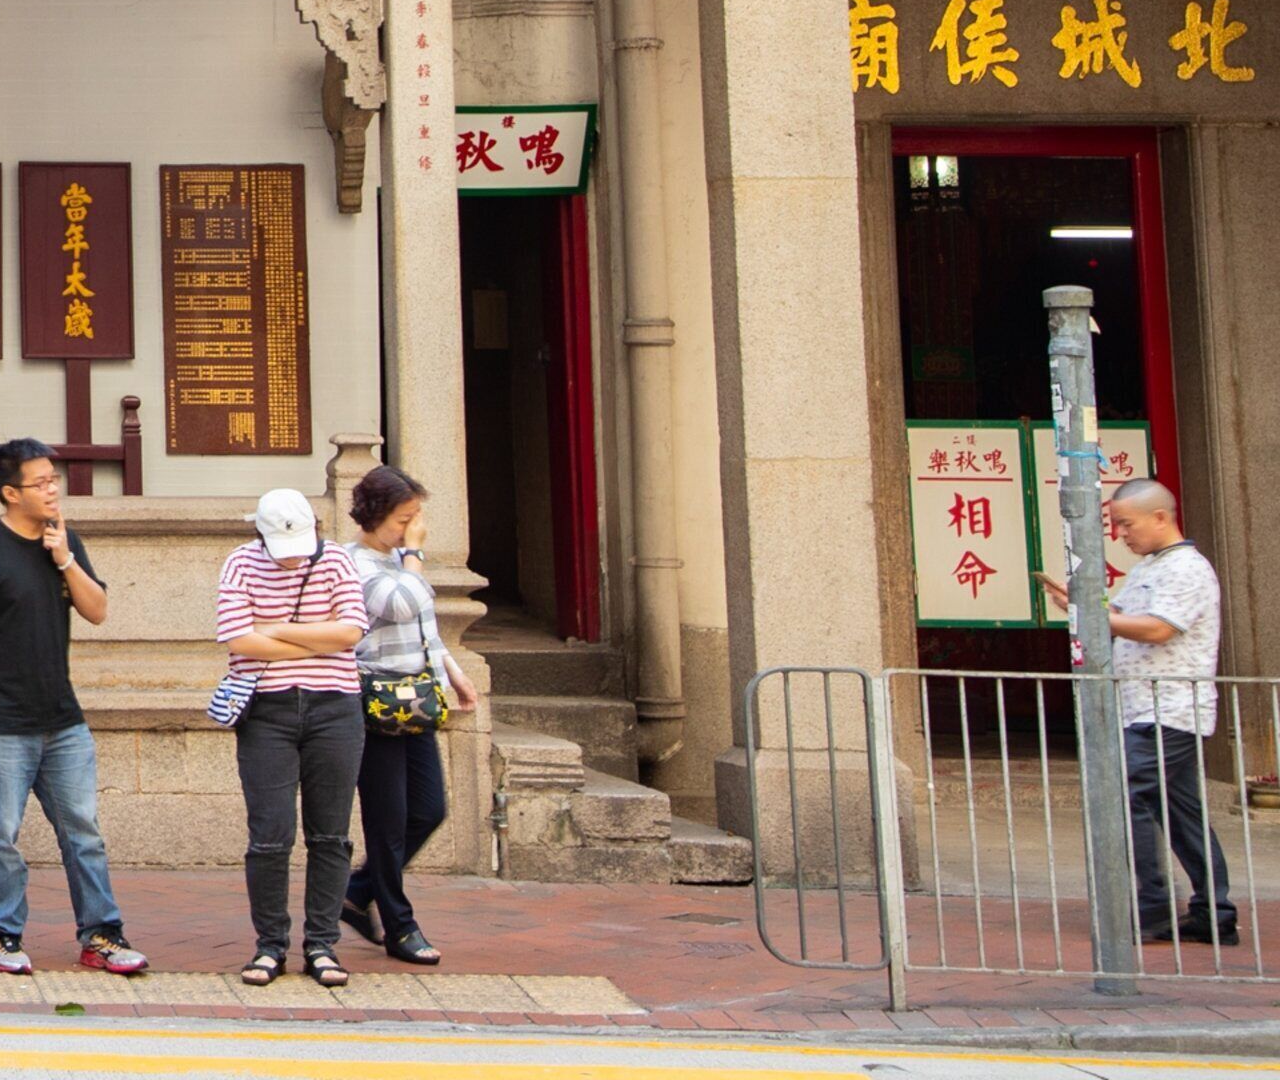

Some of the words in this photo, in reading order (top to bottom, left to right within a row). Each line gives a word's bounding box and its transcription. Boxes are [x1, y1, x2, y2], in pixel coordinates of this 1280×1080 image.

[60, 182, 96, 340] 當年太歲
[947, 492, 997, 600] 相命
